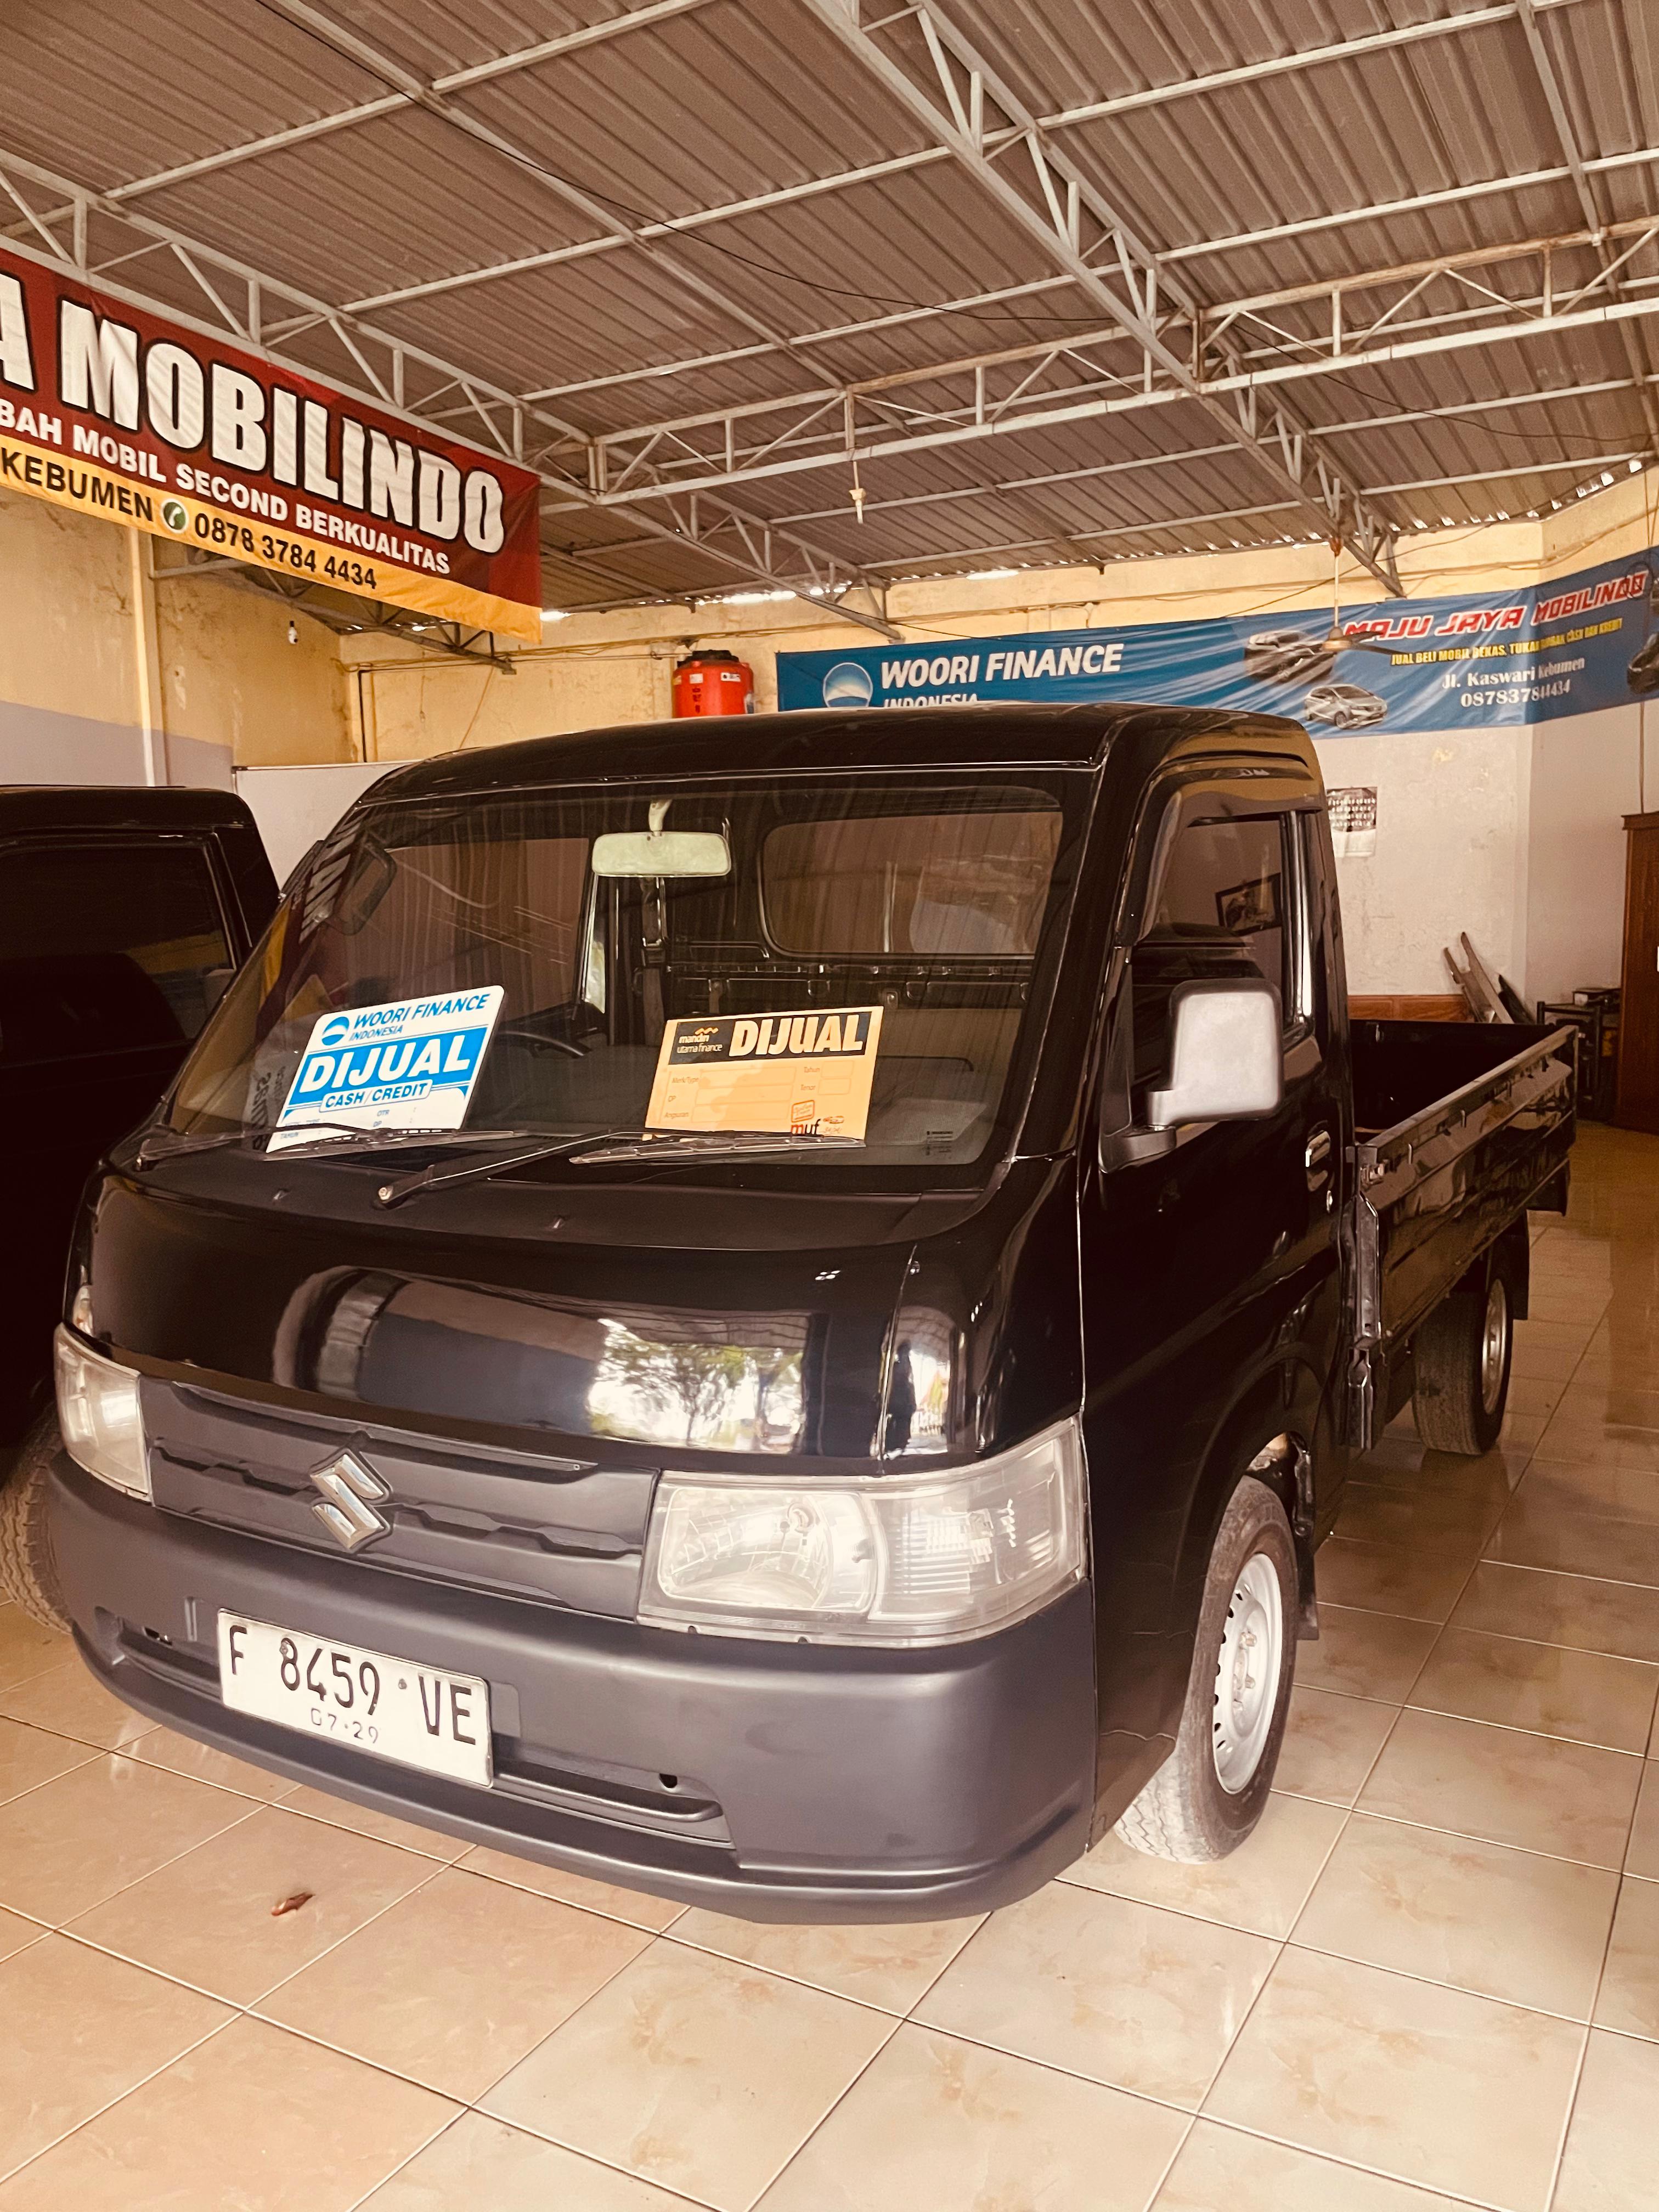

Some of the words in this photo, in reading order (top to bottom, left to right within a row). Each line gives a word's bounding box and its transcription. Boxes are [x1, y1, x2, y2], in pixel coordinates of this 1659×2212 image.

[61, 300, 504, 554] MOBILINDO
[1, 447, 154, 522] KEBUMEN
[194, 513, 255, 553] 0878
[262, 535, 317, 572] 3784
[324, 556, 377, 590] 4434
[72, 425, 167, 483] MOBIL
[176, 462, 288, 521] SECOND
[296, 503, 450, 574] BERKUALITAS
[1344, 615, 1434, 641] MAJU
[1435, 606, 1527, 636] JAYA
[1531, 570, 1649, 627] MOBILINDO
[881, 655, 979, 690] WOORI
[986, 643, 1124, 682] FINANCE
[1392, 653, 1414, 665] JUAL
[1416, 651, 1437, 663] BELI
[1442, 674, 1461, 689] Jl.
[1468, 667, 1536, 687] Kaswari
[349, 1025, 403, 1042] INDONESIA
[353, 1007, 409, 1029] WOORI
[414, 994, 491, 1020] FINANCE
[729, 1014, 864, 1057] DIJUAL
[299, 1035, 471, 1093] DIJUAL
[791, 1119, 821, 1135] muf
[229, 1624, 247, 1675] F
[280, 1637, 380, 1716] 8459
[418, 1674, 476, 1745] VE
